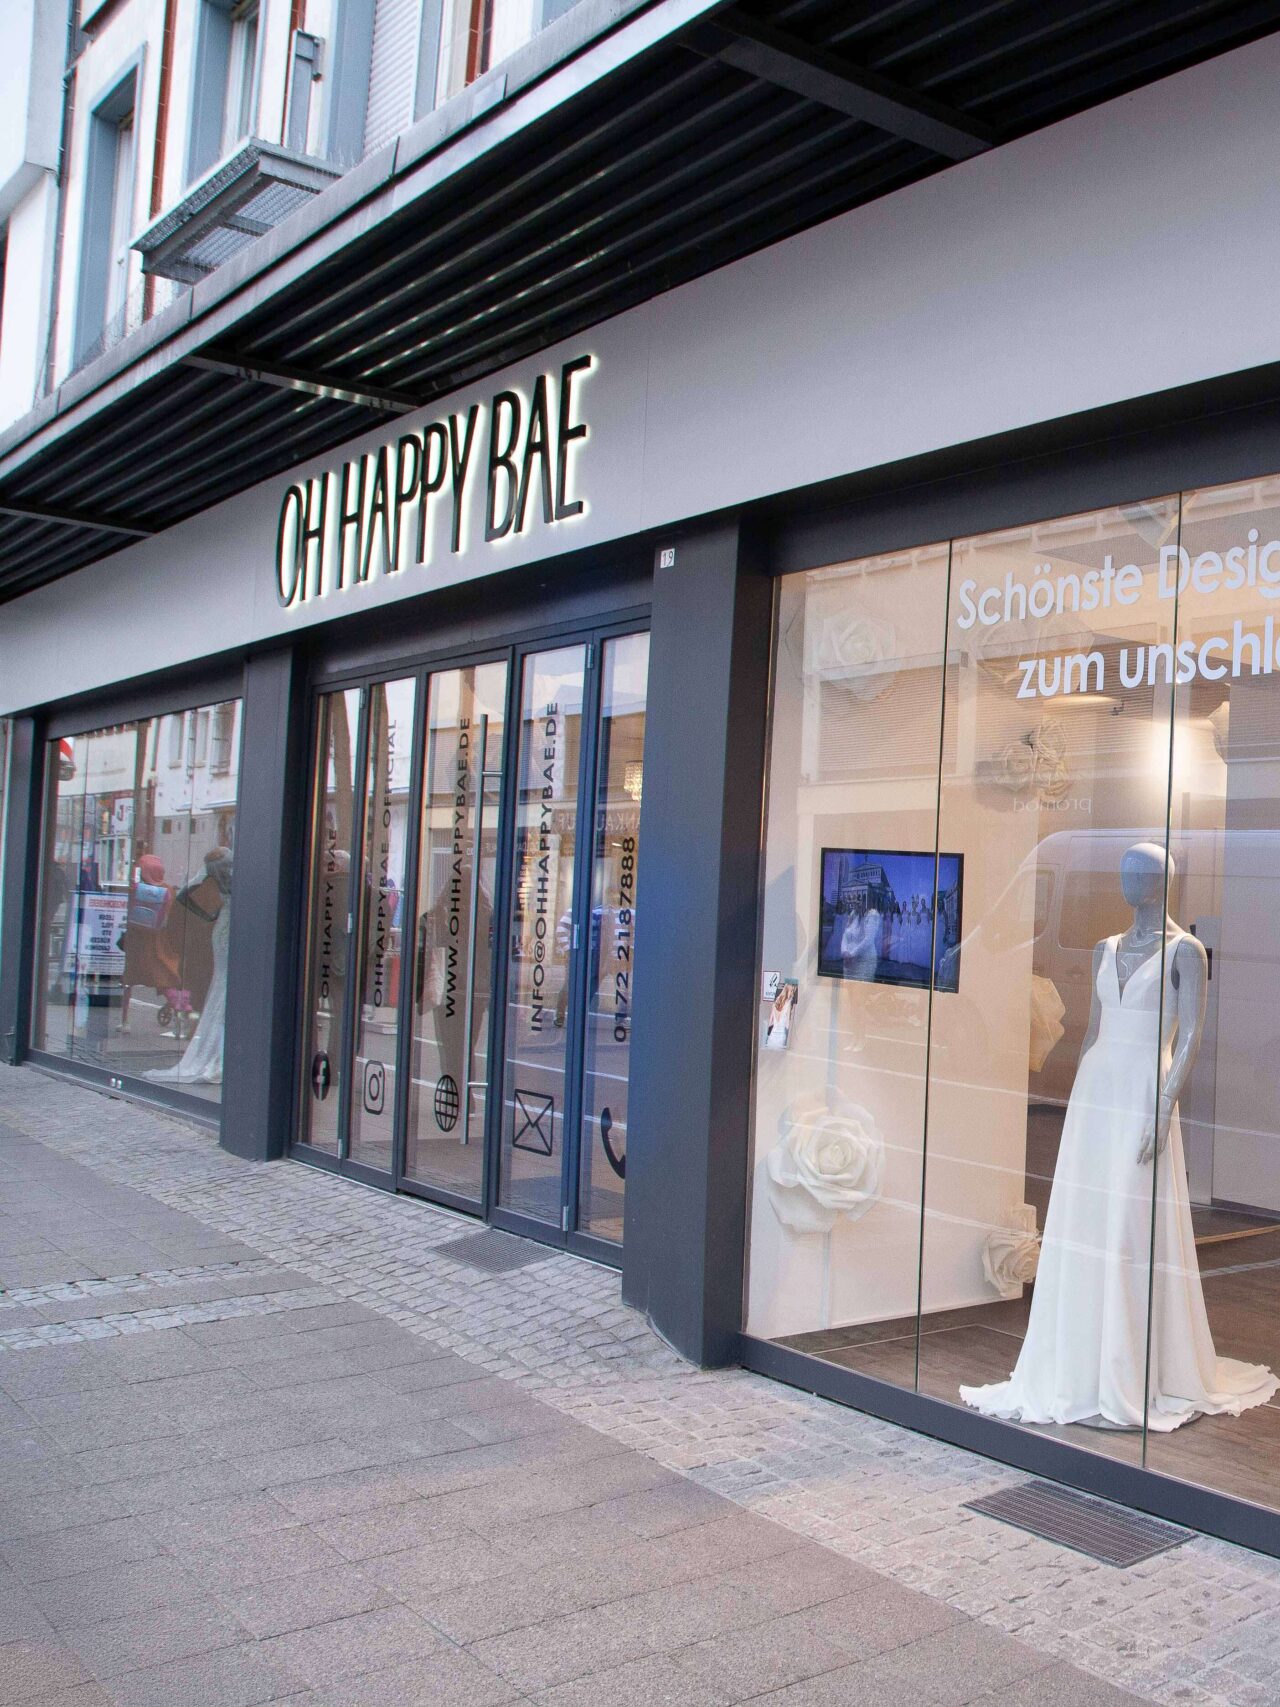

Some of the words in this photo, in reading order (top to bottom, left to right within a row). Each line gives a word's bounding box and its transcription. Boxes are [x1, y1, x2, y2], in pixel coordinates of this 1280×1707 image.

[276, 471, 331, 608] OH
[336, 404, 480, 590] HAPPY
[484, 354, 592, 543] BAE
[663, 550, 673, 567] 19
[957, 555, 1143, 630] Schönste
[1016, 648, 1105, 699] zum
[327, 828, 338, 872] BAE
[446, 717, 471, 1018] WWW.OHHAPPYBAE.DE
[531, 701, 558, 1032] INFO@OHHAPPYBAE.DE
[323, 881, 335, 955] HAPPY
[617, 836, 635, 961] 2187888
[321, 964, 331, 999] OH
[613, 972, 629, 1043] 0172
